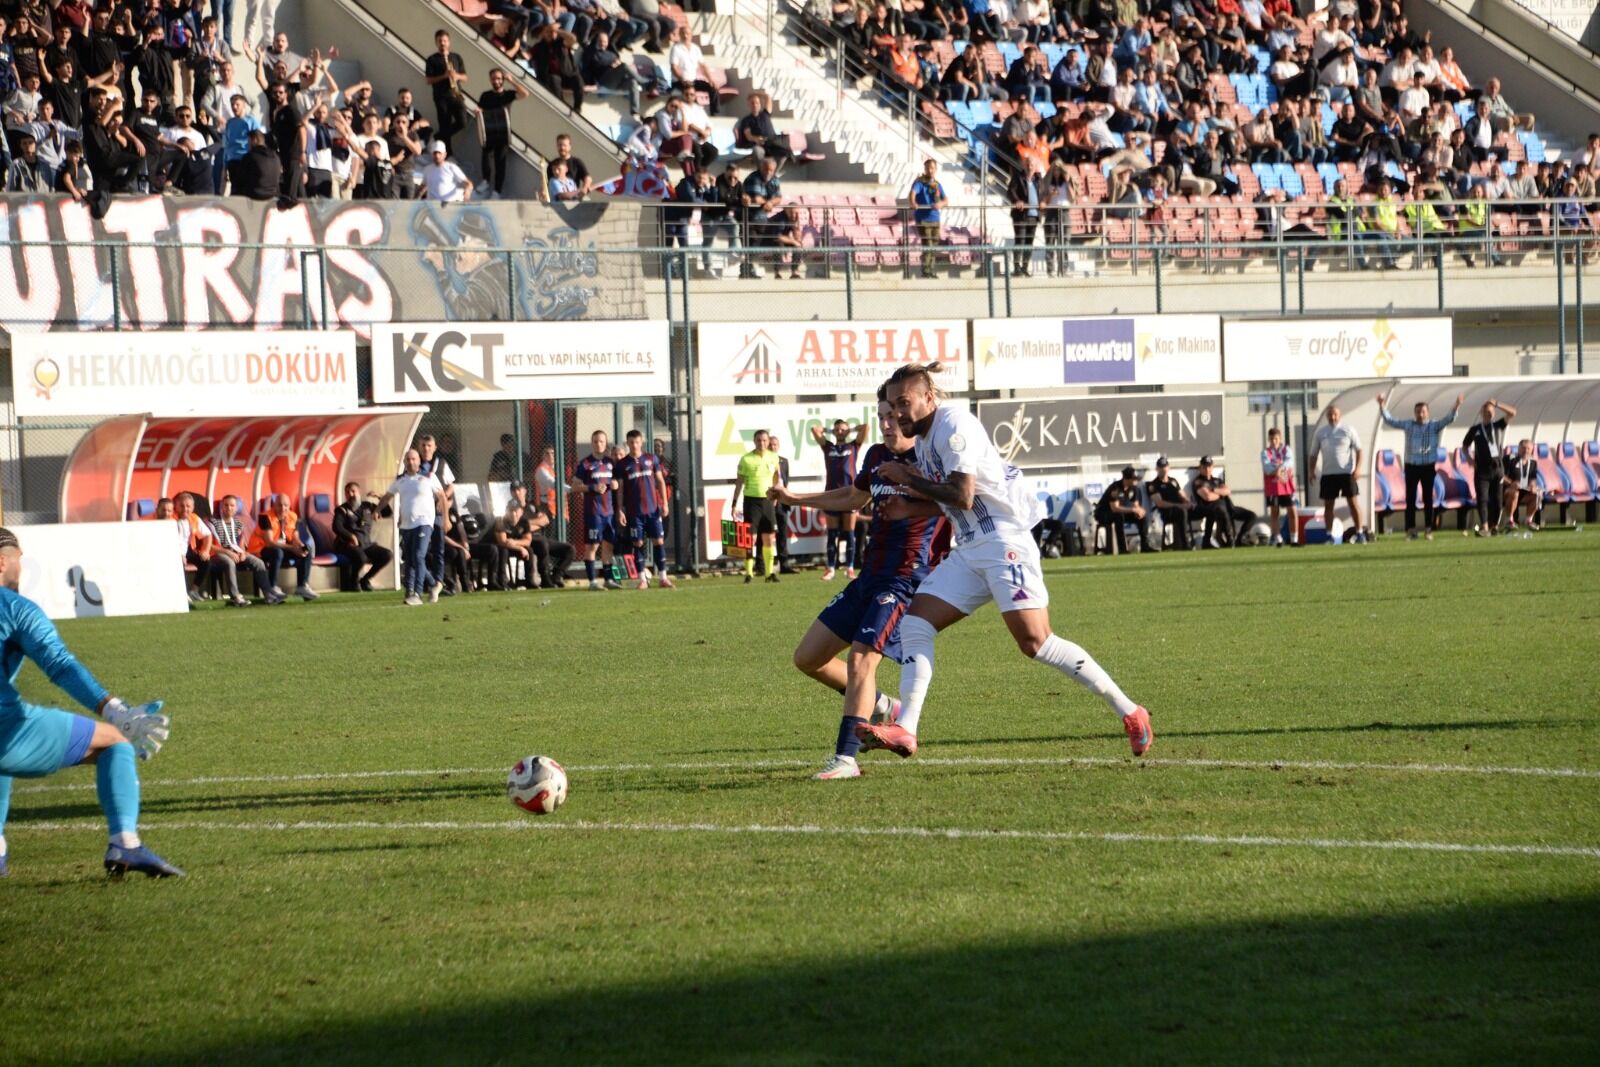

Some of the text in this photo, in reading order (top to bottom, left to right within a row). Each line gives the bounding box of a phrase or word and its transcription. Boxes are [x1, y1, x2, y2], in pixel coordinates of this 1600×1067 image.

[0, 195, 394, 340] ULTRAS
[796, 328, 960, 364] ARHAL
[997, 340, 1061, 360] Koç Makina
[1065, 339, 1133, 363] KOMATSU
[1154, 336, 1216, 355] Koç Makina
[1308, 330, 1369, 362] ardiye
[392, 331, 505, 393] KCT
[504, 353, 524, 367] KCT
[526, 353, 546, 366] YOL
[549, 352, 573, 366] YAPI
[575, 349, 612, 370] İNŞAAT
[796, 367, 834, 379] ARHAL
